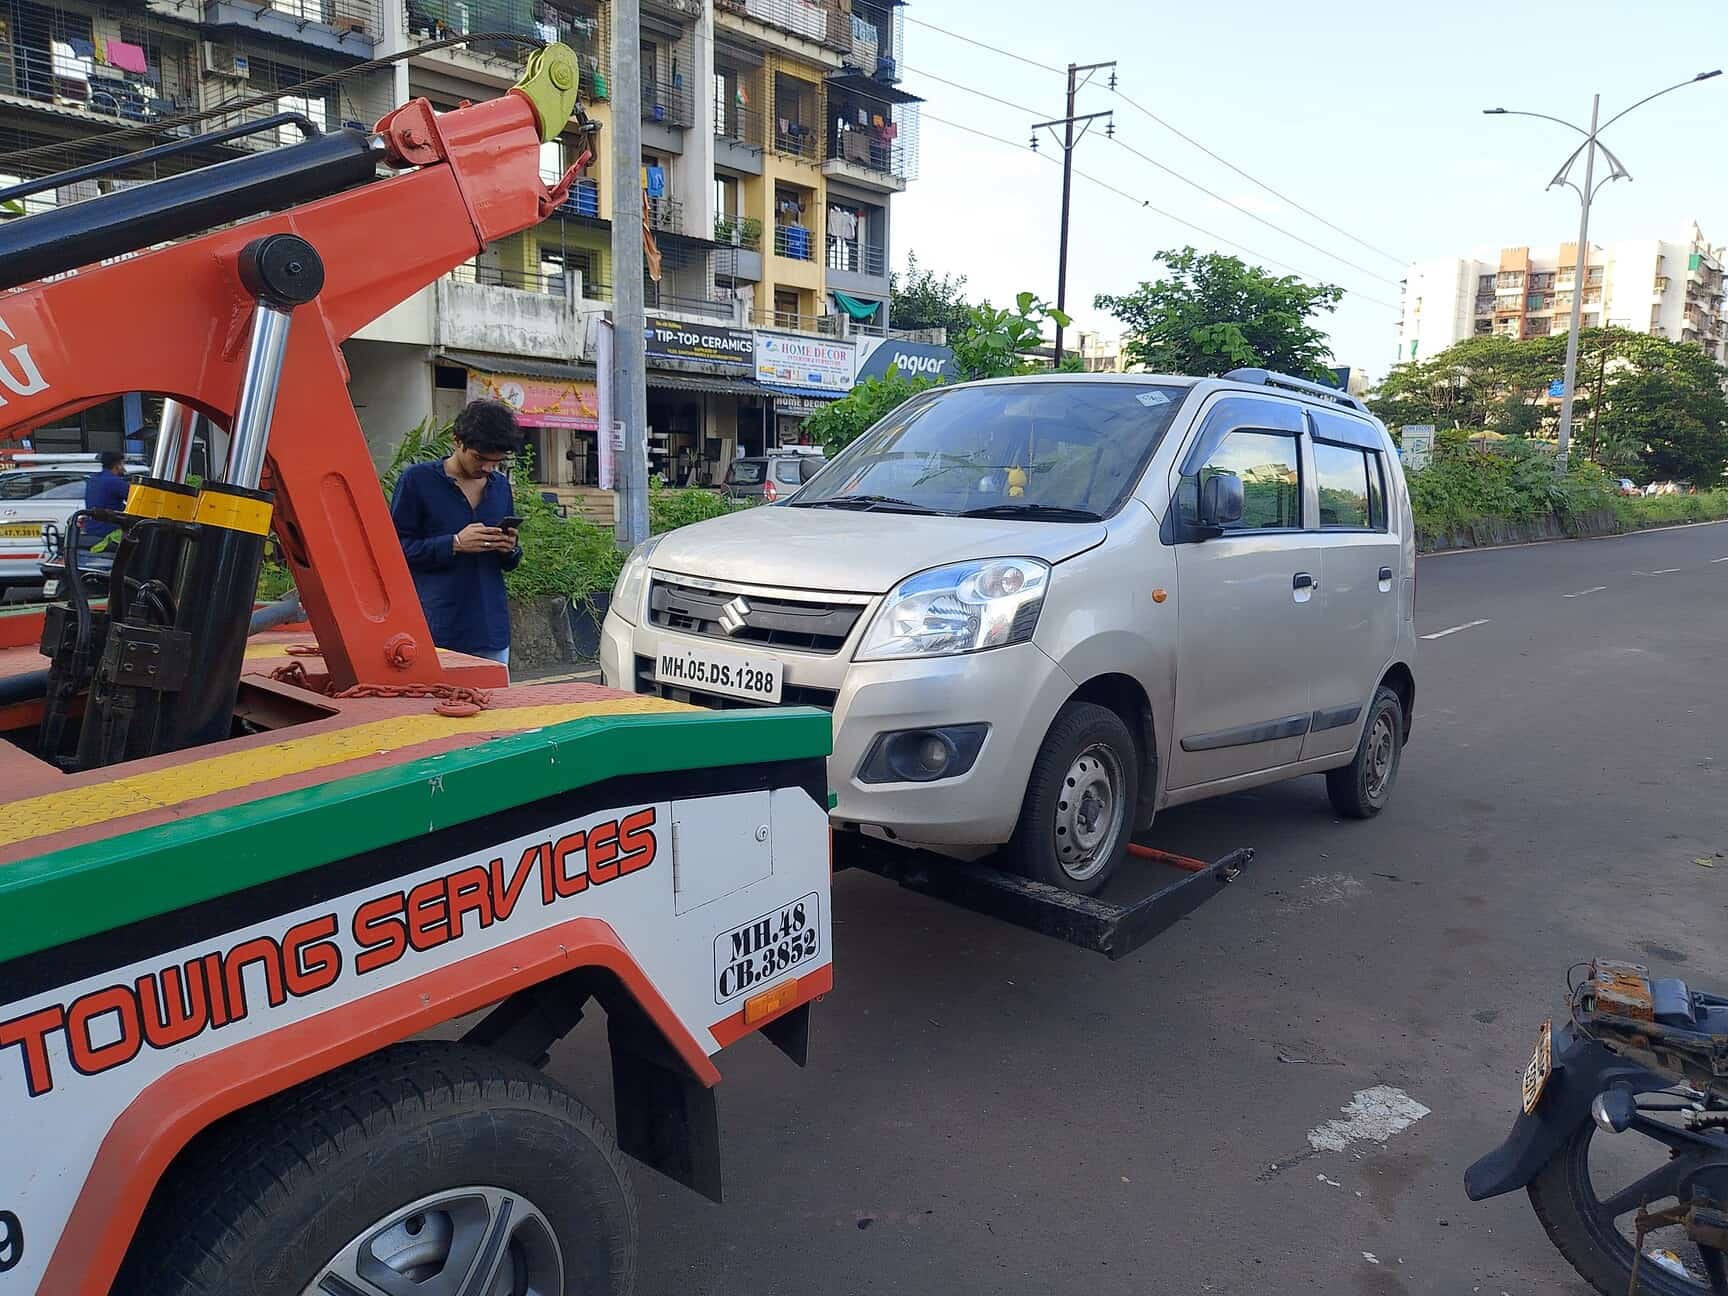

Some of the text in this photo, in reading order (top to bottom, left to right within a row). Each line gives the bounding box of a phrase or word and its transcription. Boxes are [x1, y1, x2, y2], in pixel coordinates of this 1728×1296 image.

[655, 329, 700, 346] TIP-TOP
[701, 335, 752, 353] CERAMICS
[781, 343, 812, 357] HOME
[814, 347, 847, 361] DECOR
[661, 655, 774, 694] MH.05.DS.1288
[0, 807, 657, 1098] TOWING SERVICES
[729, 902, 806, 963] MH.48
[719, 928, 817, 997] CB.3852
